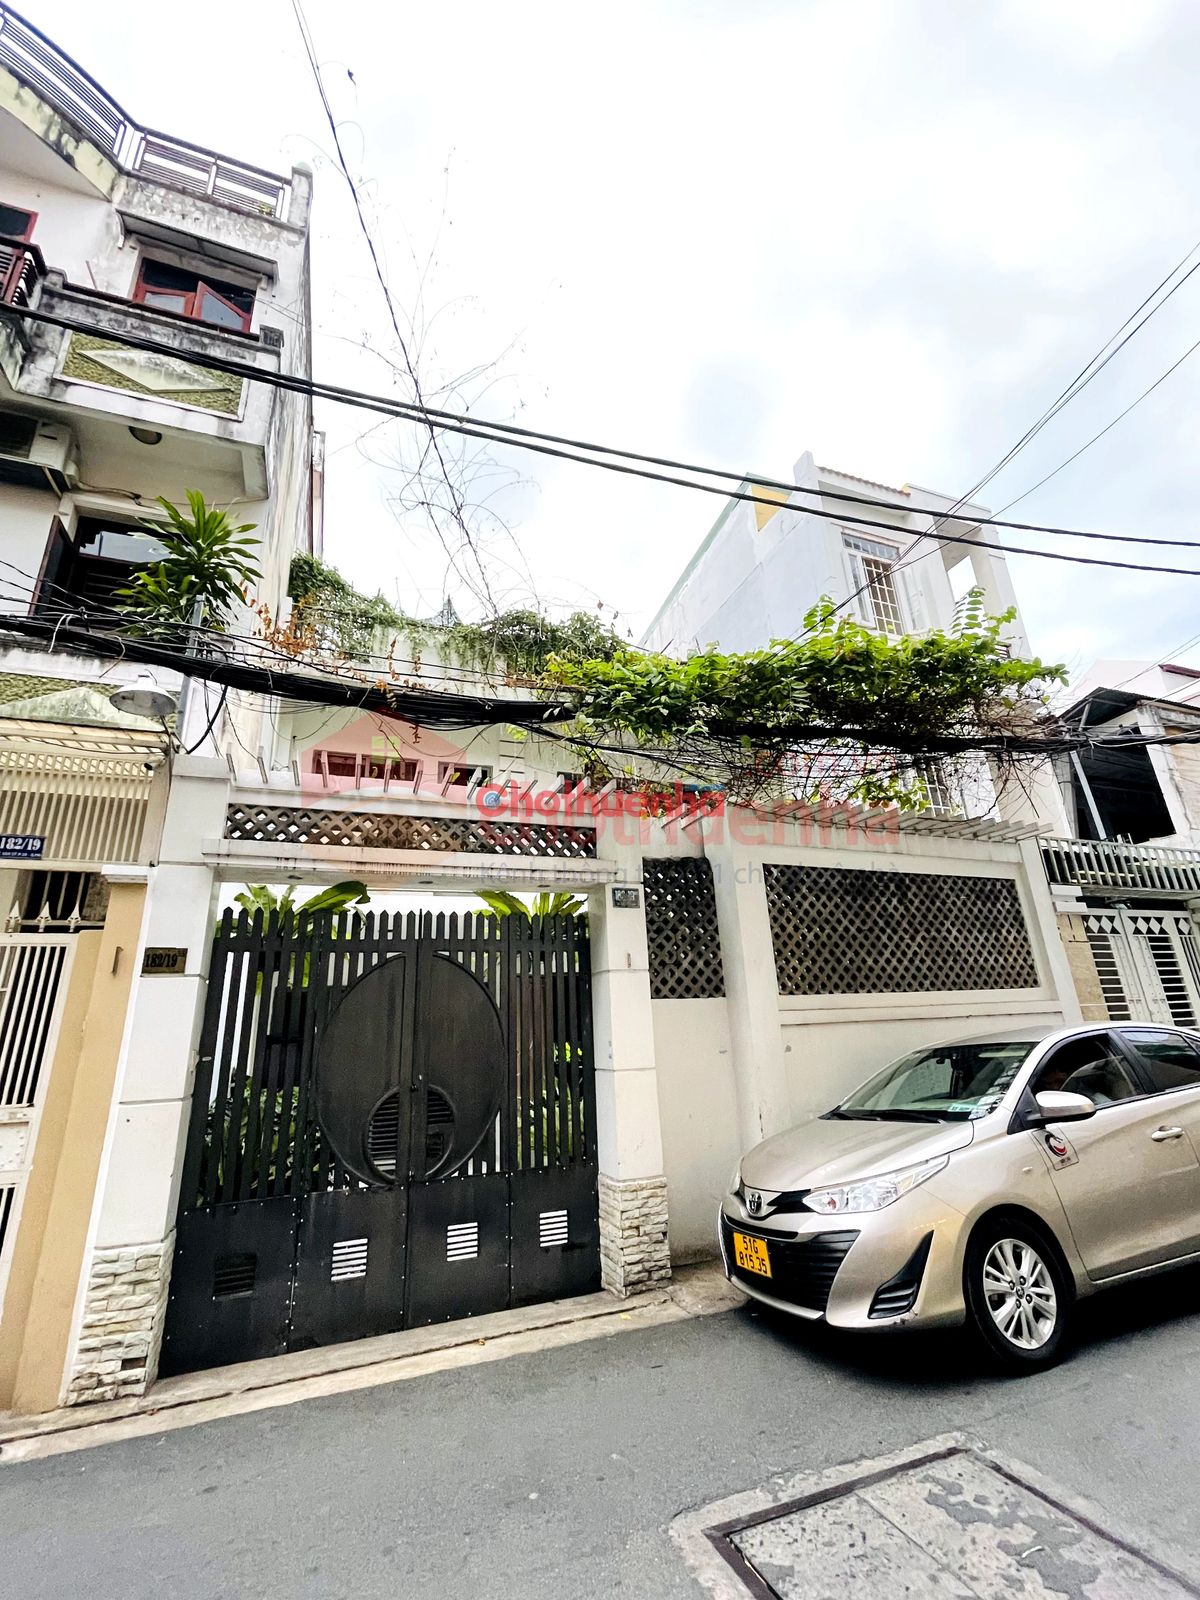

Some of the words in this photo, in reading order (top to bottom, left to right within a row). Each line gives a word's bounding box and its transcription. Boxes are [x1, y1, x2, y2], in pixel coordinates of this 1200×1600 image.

[0, 837, 41, 850] 182/19
[144, 953, 178, 967] 182/19
[742, 1236, 759, 1254] 51G
